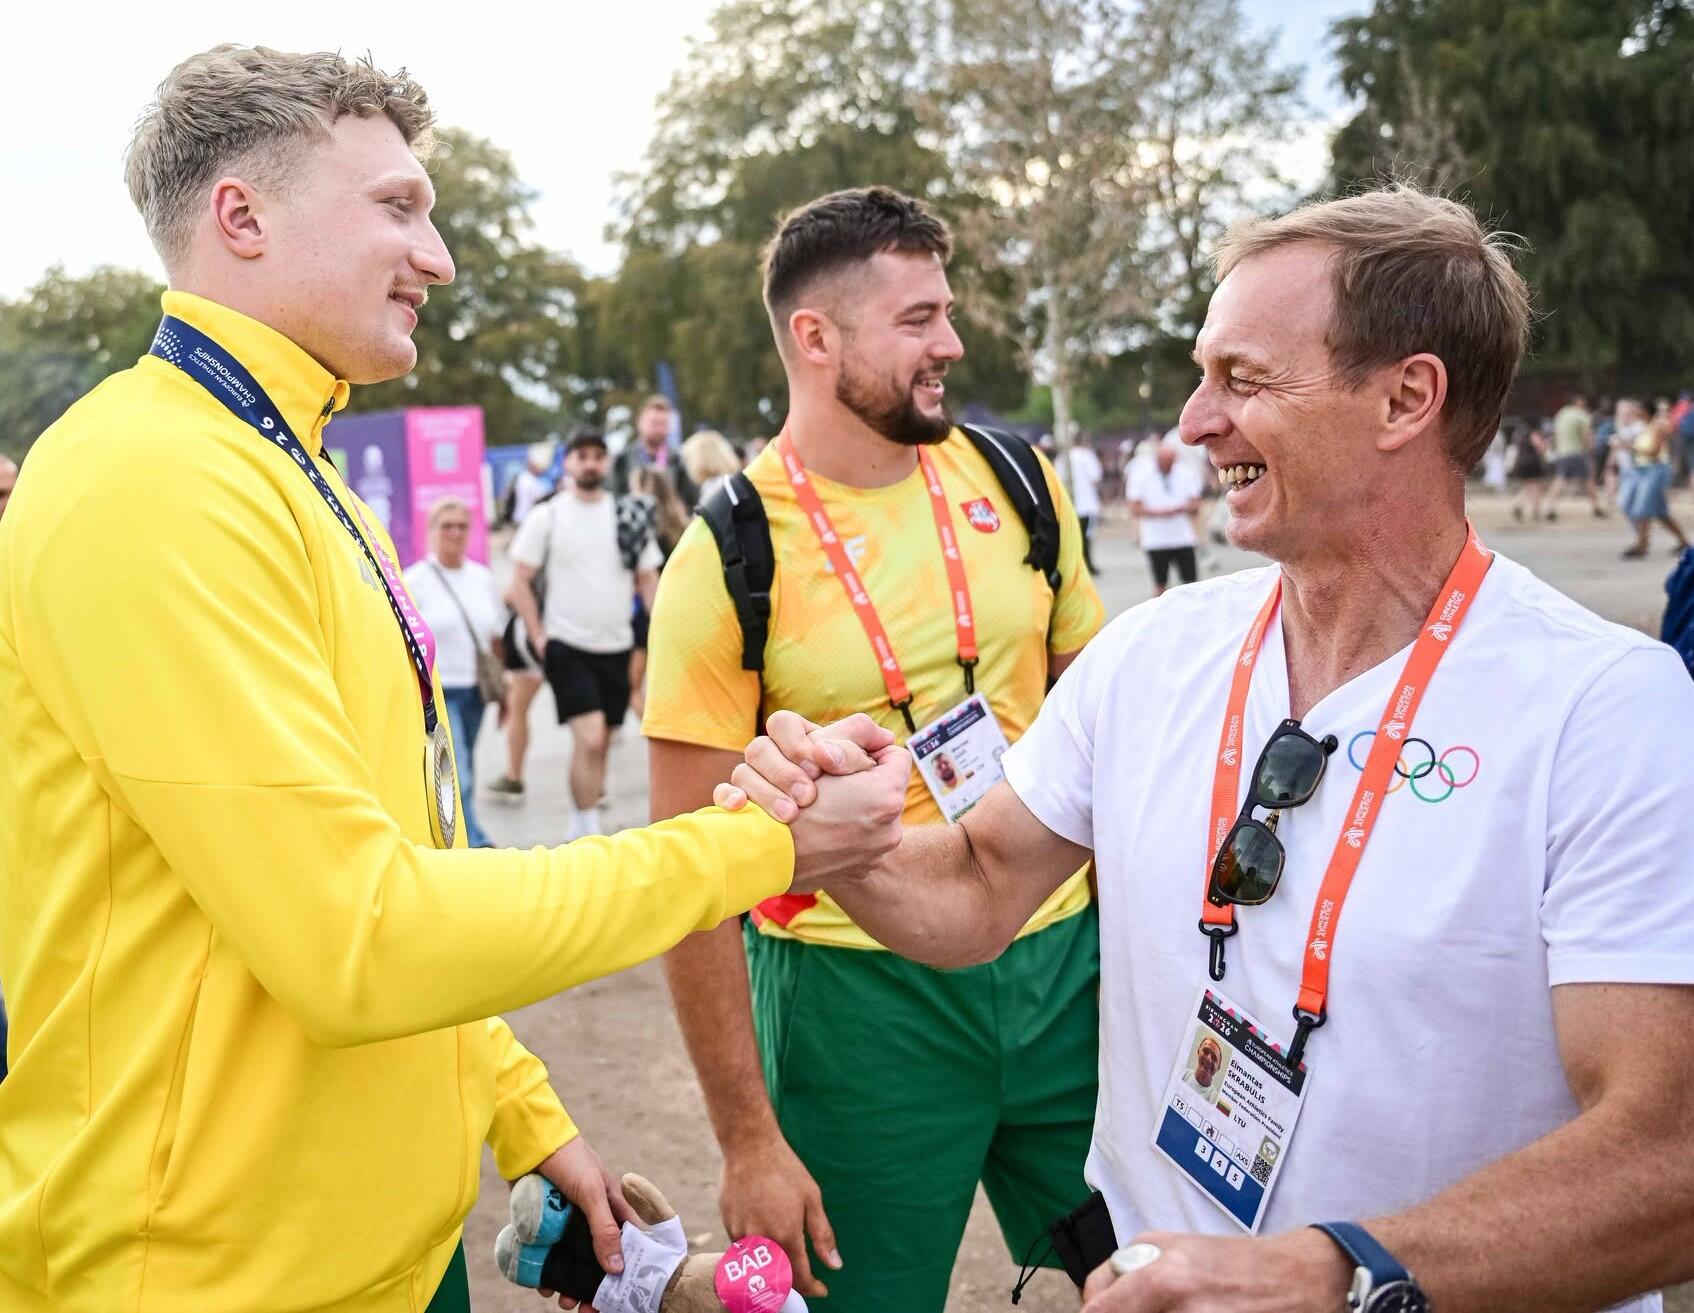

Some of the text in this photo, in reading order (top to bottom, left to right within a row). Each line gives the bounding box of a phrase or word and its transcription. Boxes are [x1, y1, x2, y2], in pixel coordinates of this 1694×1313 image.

[188, 353, 243, 402] EUROPEAN ATHLETICS
[193, 346, 255, 404] CHAMPIONSHIPS
[1230, 1059, 1264, 1089] Eimantas
[1244, 1044, 1291, 1084] CHAMPIONSHIPS
[1227, 1070, 1266, 1104] SKRABULIS
[1224, 1081, 1284, 1132] European Athletics Family
[1233, 1115, 1246, 1128] LTU
[1200, 1145, 1207, 1154] 3
[1215, 1159, 1223, 1168] 4
[1232, 1173, 1239, 1182] 5
[724, 1245, 772, 1281] BAB
